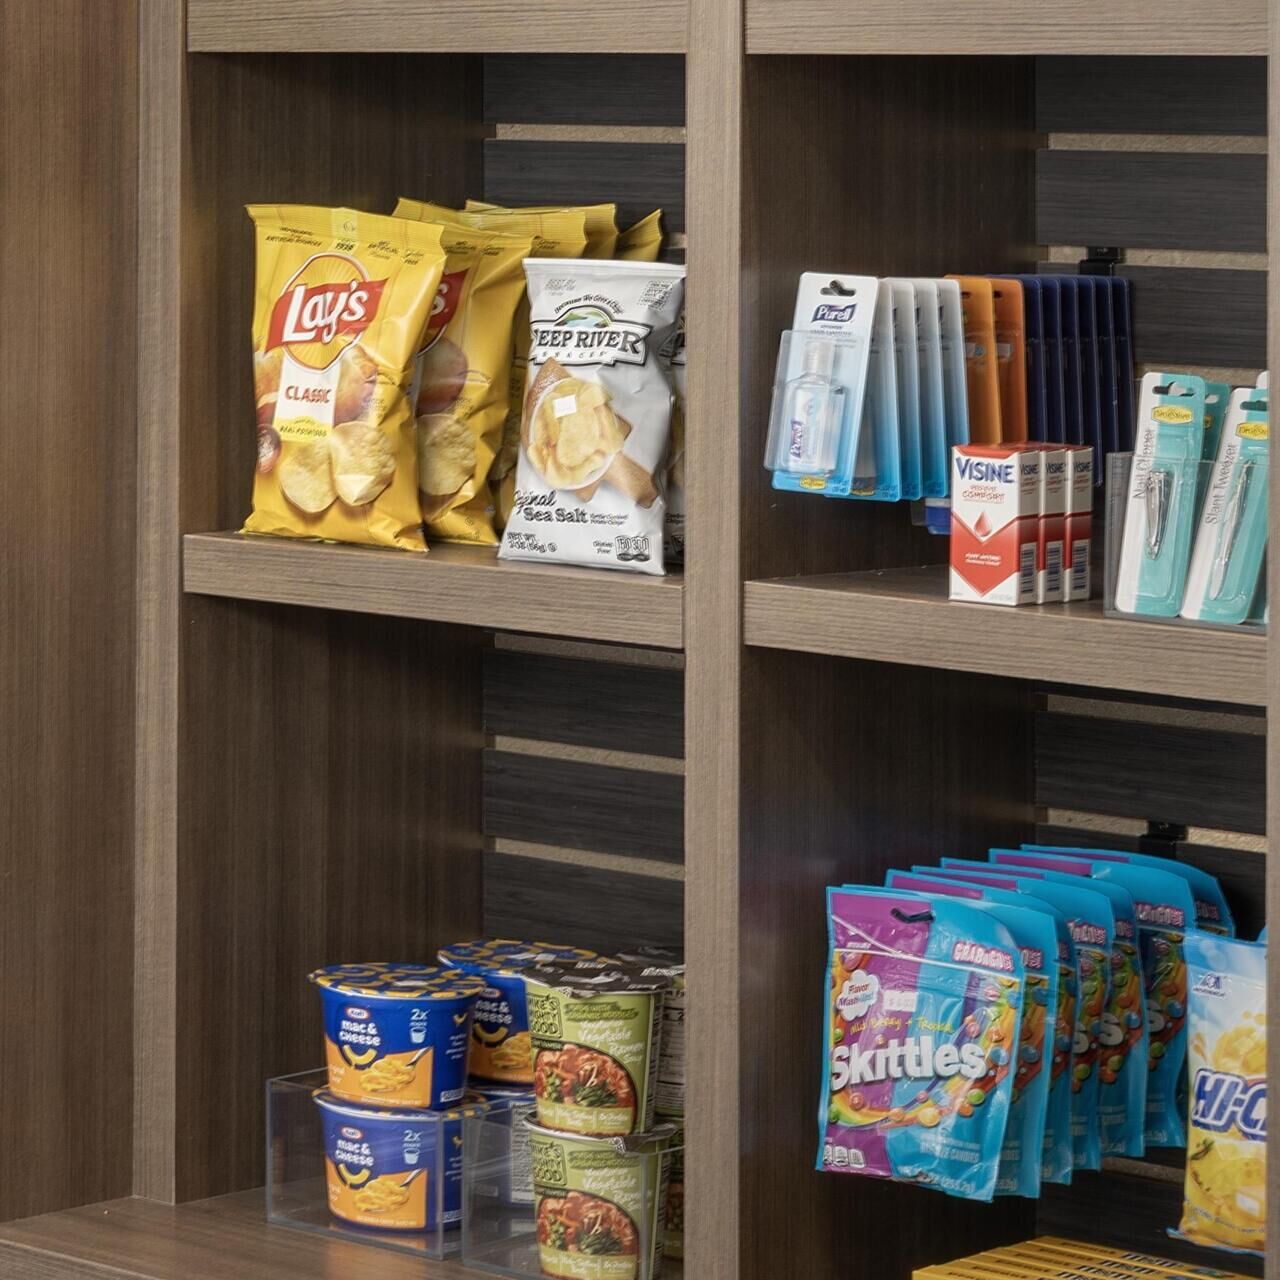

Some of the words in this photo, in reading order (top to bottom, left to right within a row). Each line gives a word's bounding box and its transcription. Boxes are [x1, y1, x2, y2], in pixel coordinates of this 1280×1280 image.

[282, 280, 368, 344] Lay's
[816, 304, 853, 321] Purell
[574, 329, 641, 355] RIVER
[284, 384, 331, 403] CLASSIC
[955, 456, 1015, 484] VISINE
[1214, 443, 1237, 494] Tweezer
[523, 507, 554, 524] Sea
[555, 508, 589, 524] Salt
[1204, 492, 1225, 526] Slant
[847, 983, 871, 994] Flavor
[341, 1019, 366, 1034] mac
[366, 1022, 378, 1035] &
[830, 1033, 989, 1094] Skittles
[1192, 1069, 1267, 1142] HI-C
[336, 1138, 359, 1154] mac
[360, 1142, 372, 1156] &
